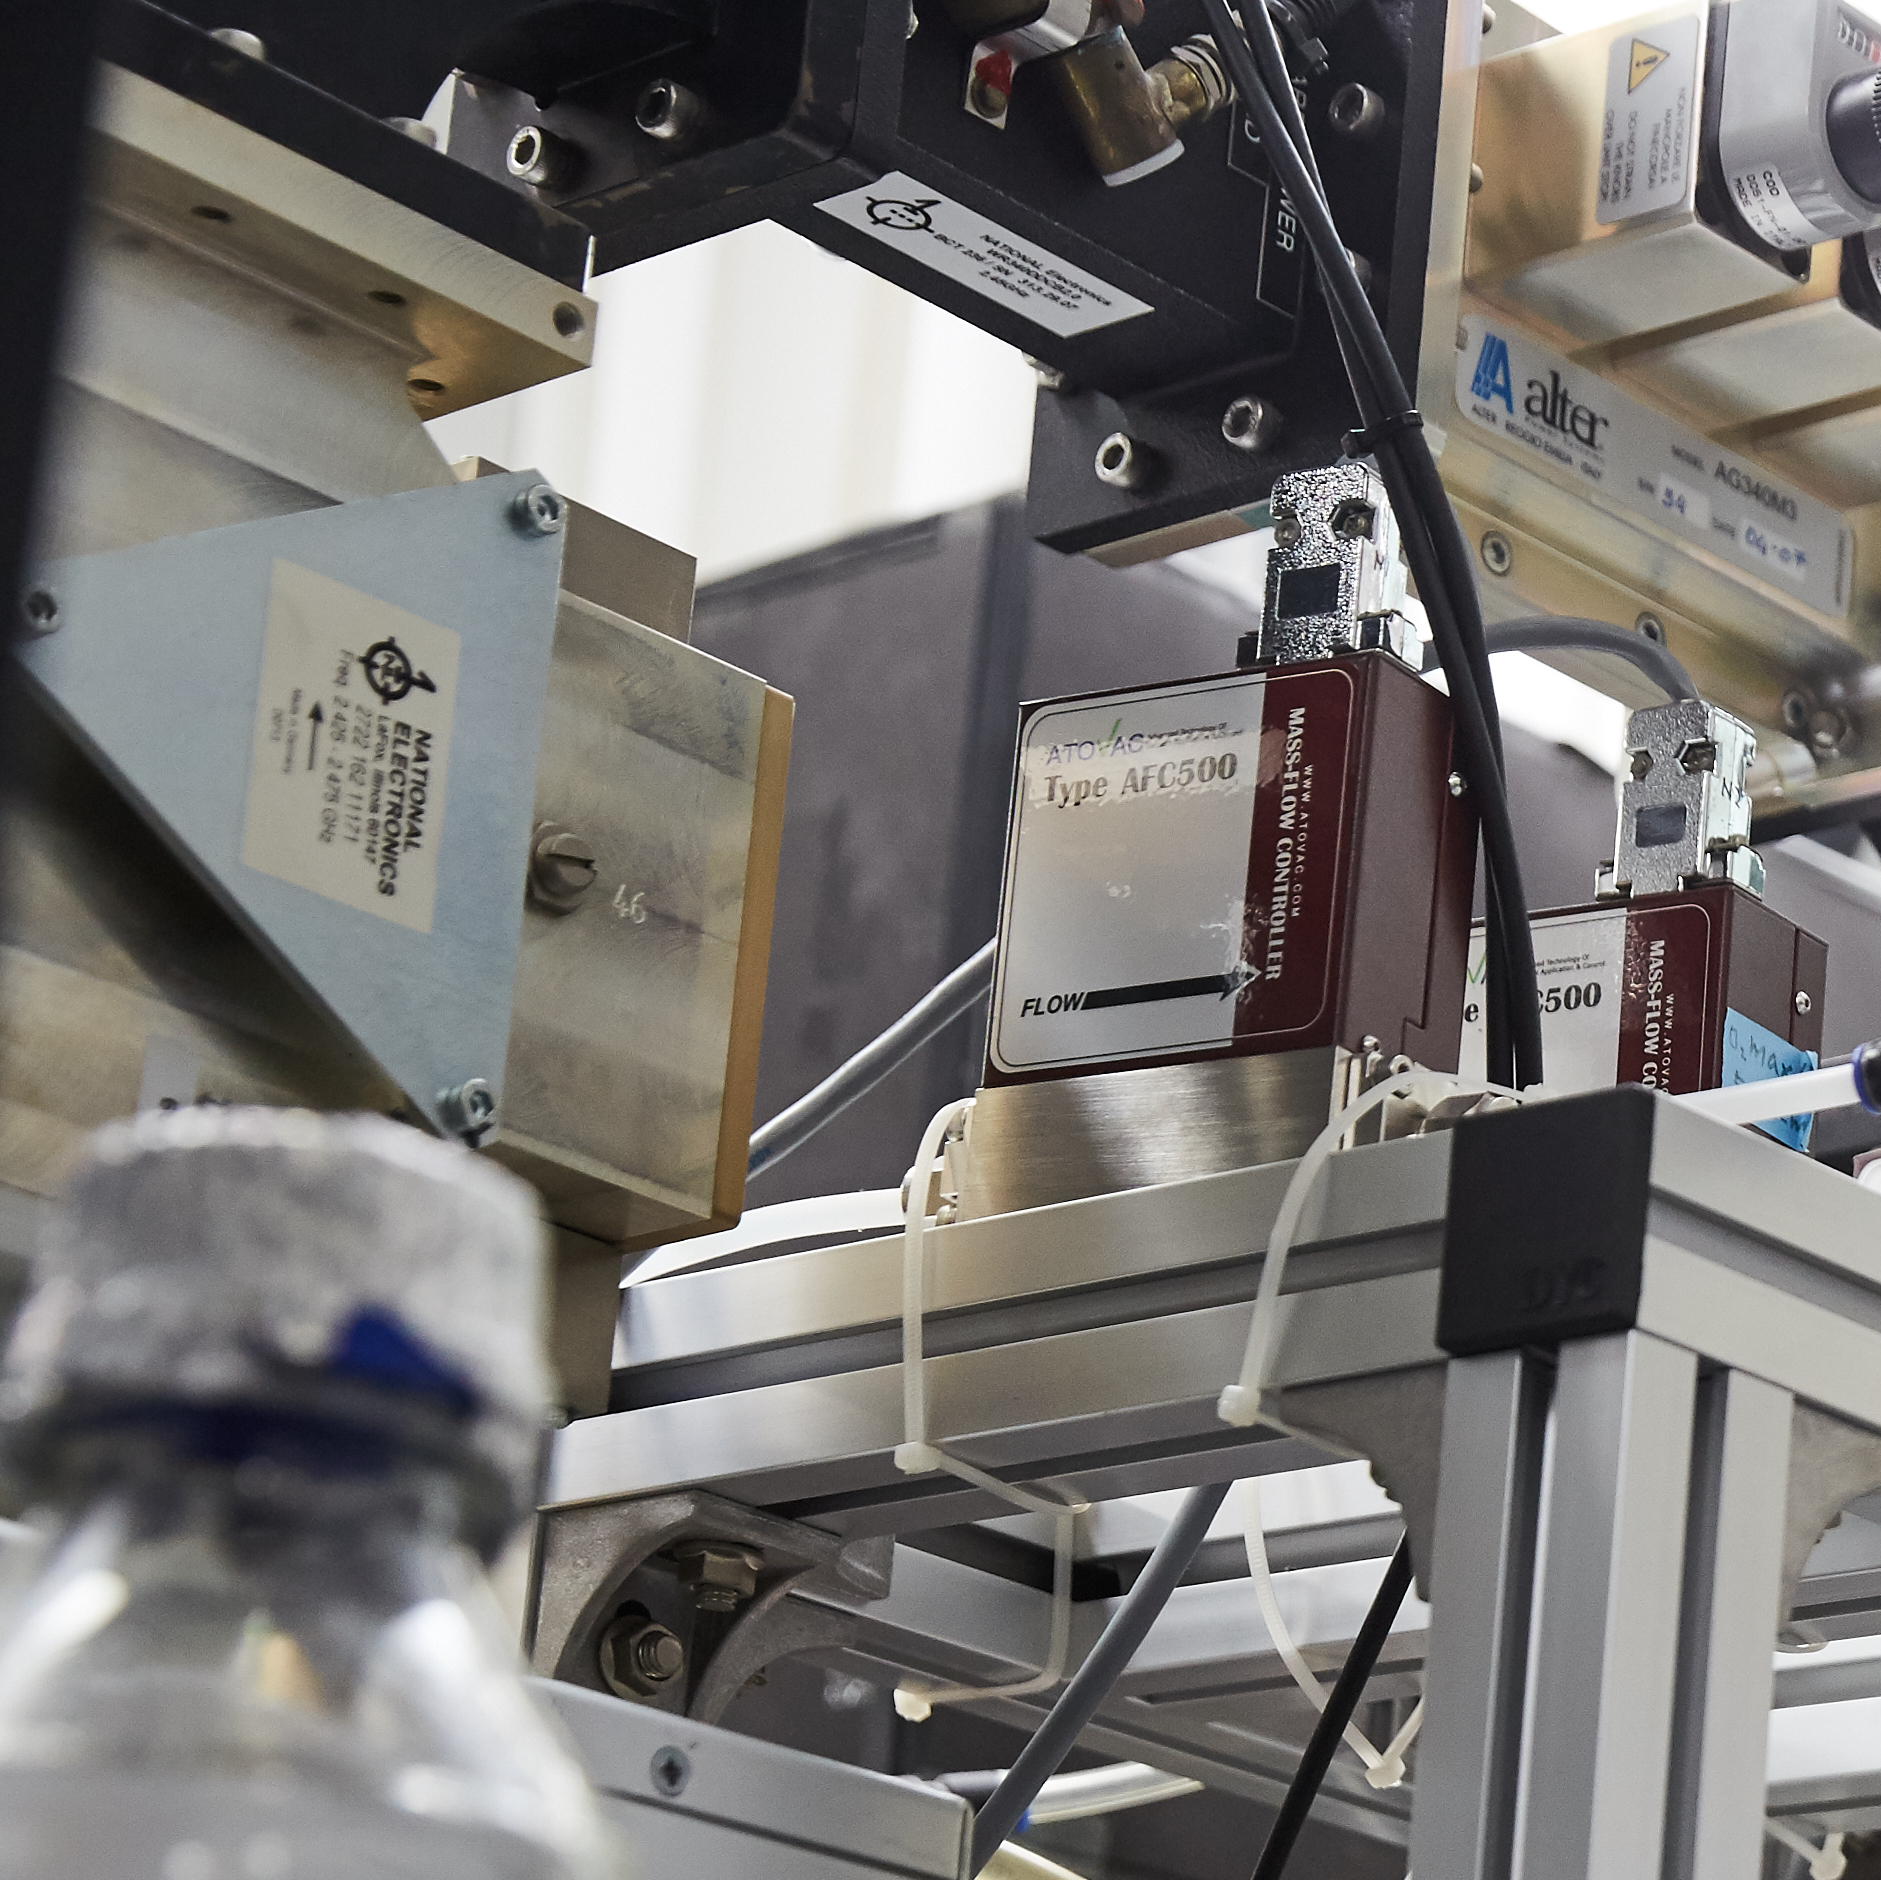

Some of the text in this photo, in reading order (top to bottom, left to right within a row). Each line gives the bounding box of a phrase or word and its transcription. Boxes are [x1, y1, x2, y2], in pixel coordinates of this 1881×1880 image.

[1762, 169, 1780, 197] COD
[1523, 369, 1609, 449] alter
[352, 704, 373, 750] 2722
[348, 756, 367, 787] 162
[403, 729, 432, 852] NATIONAL
[1044, 753, 1238, 809] Type AFC500
[378, 721, 412, 897] ELECTRONICS
[1265, 706, 1306, 981] MASS-FLOW CONTROLLER
[612, 884, 645, 924] 46
[1020, 991, 1085, 1018] FLOW
[1644, 939, 1665, 1055] MASS-FLOW
